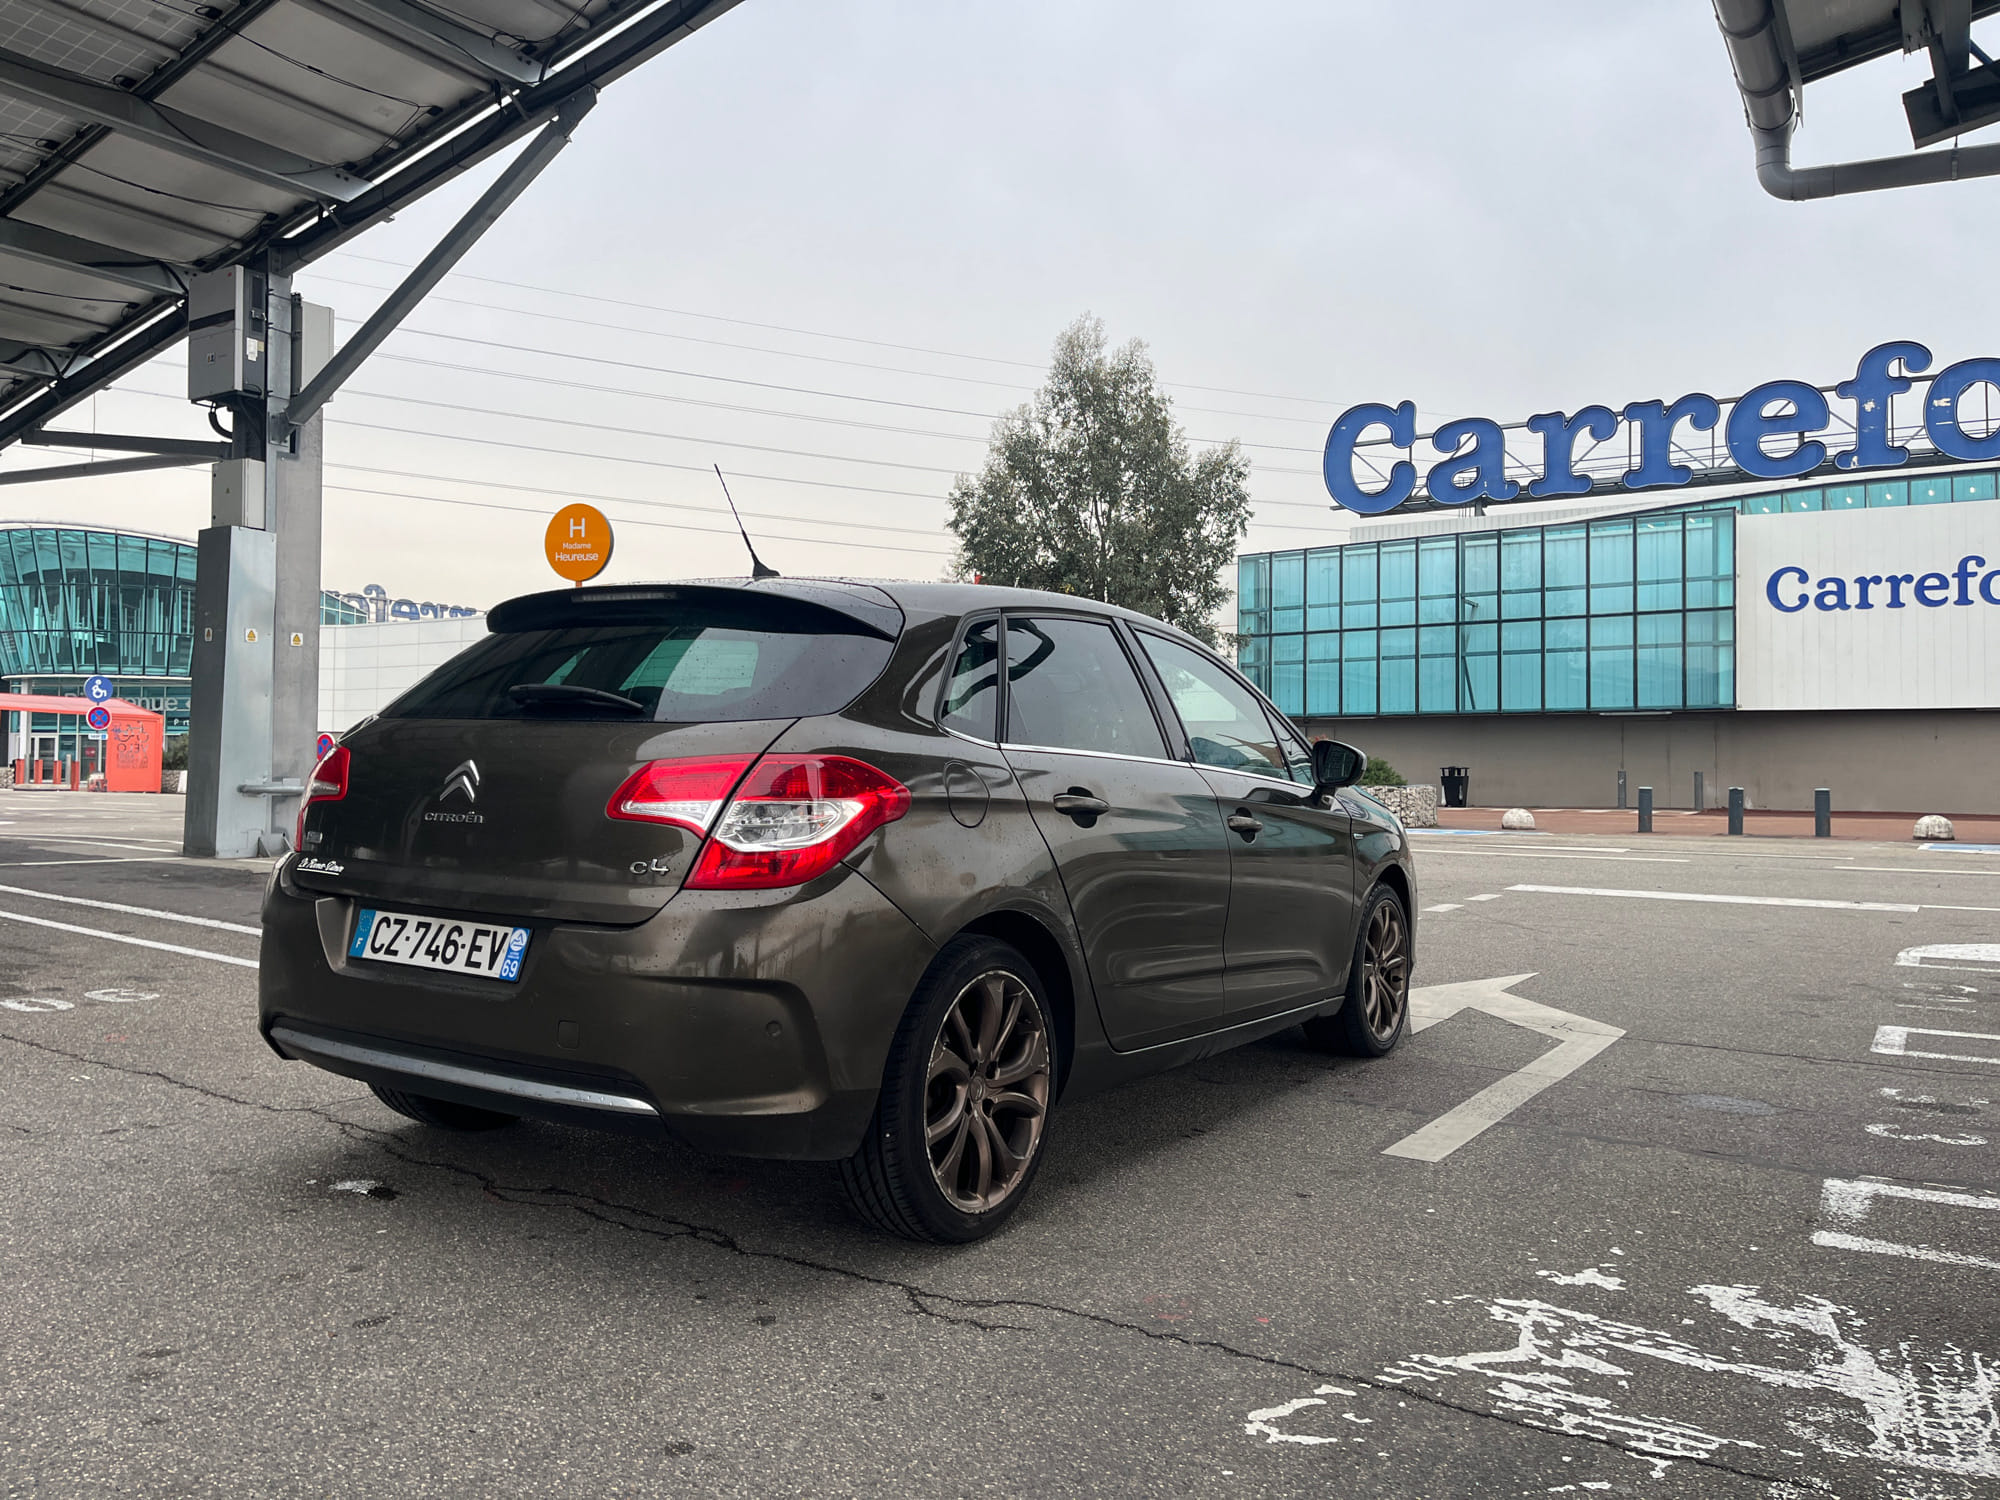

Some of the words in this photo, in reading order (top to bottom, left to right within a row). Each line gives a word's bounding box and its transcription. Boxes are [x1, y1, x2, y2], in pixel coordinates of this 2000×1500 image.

[1324, 341, 2000, 514] Carrefo
[569, 517, 586, 538] H
[562, 542, 592, 550] Madame
[555, 552, 599, 561] Heureuse
[501, 959, 519, 978] 69
